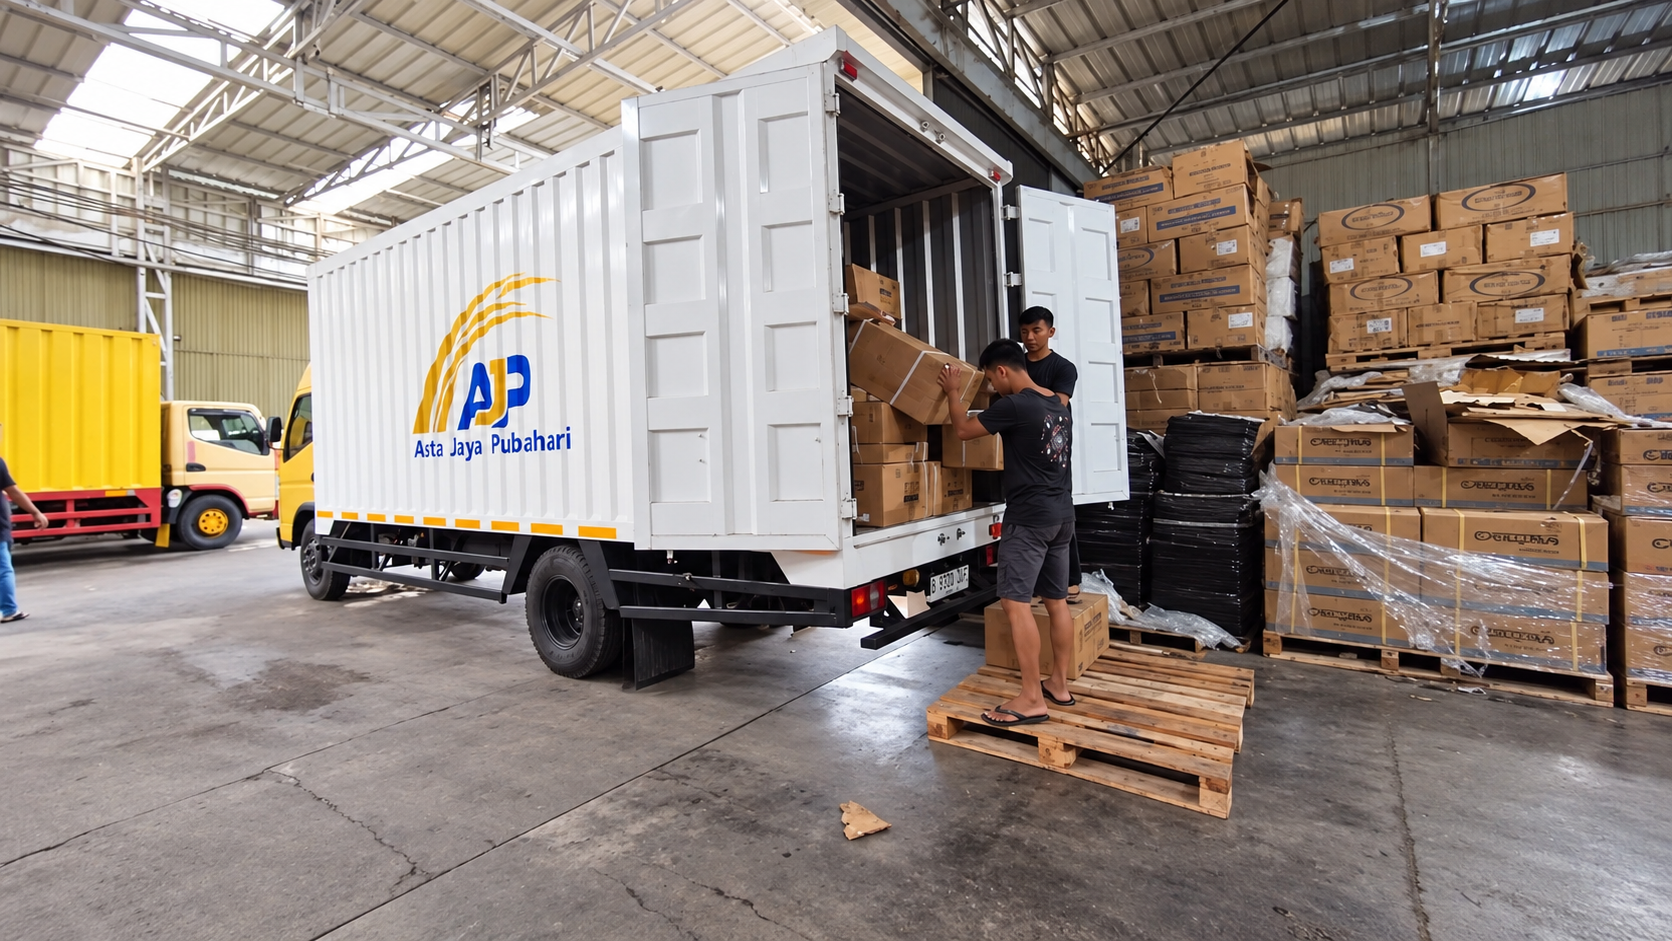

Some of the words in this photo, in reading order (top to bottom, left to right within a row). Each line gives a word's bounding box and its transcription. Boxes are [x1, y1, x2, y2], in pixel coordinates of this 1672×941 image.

[457, 354, 531, 431] AJP
[414, 440, 444, 458] Asta
[450, 437, 482, 461] Jaya
[491, 426, 571, 454] Pubahari
[931, 578, 937, 594] B
